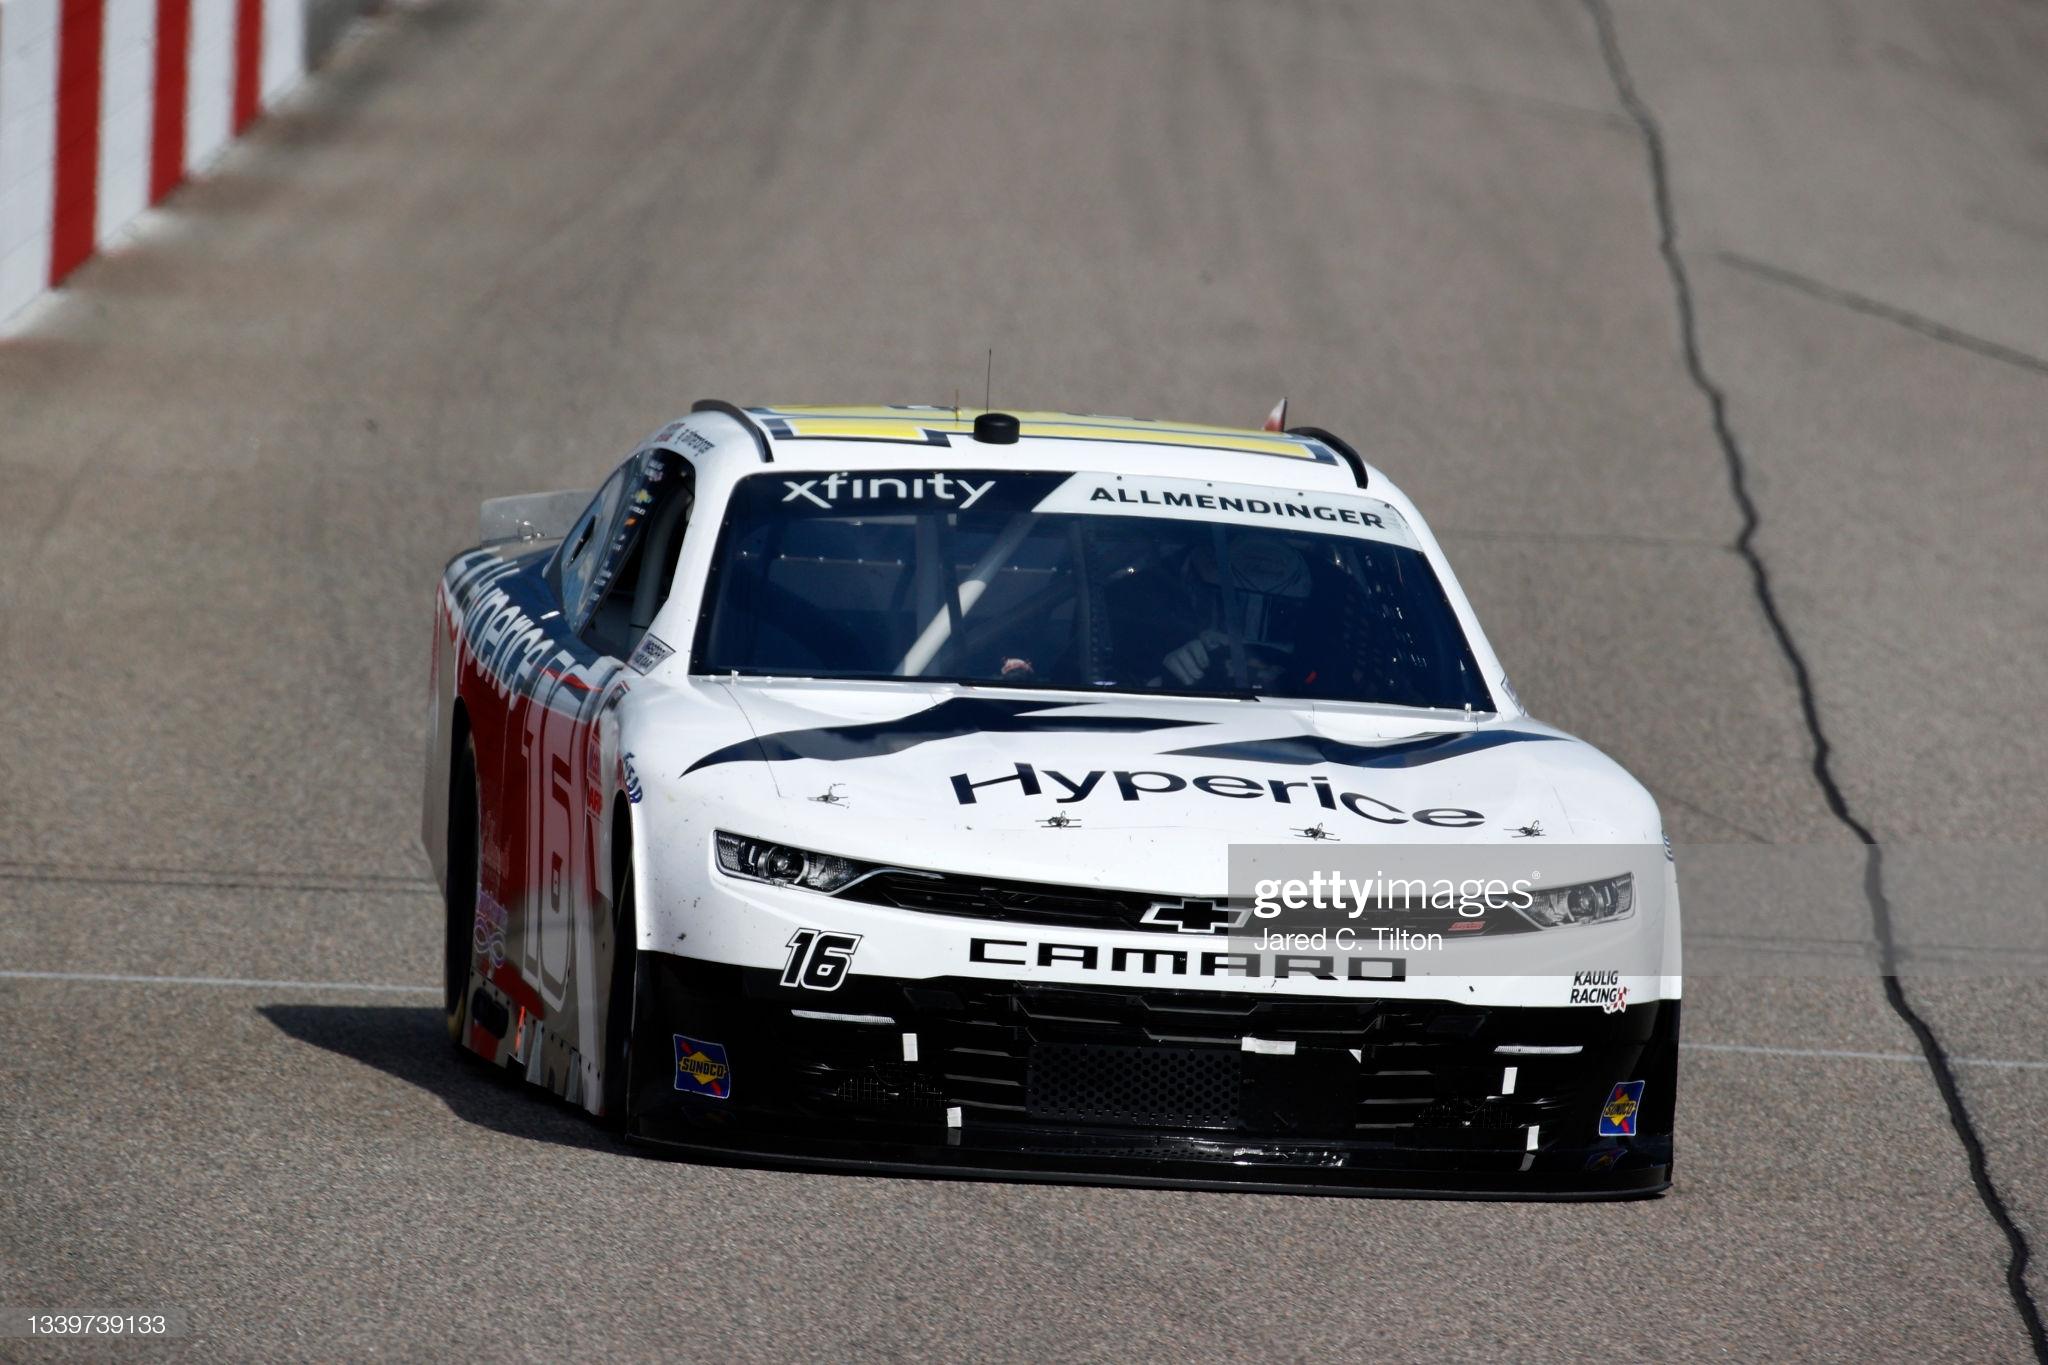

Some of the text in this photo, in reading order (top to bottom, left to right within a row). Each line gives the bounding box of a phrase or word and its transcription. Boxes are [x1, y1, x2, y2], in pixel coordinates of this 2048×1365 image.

[782, 471, 997, 510] xfinity
[1089, 486, 1386, 529] ALLMENDINGER
[949, 762, 1486, 829] Hyperice
[780, 928, 863, 992] 16
[968, 937, 1407, 983] CAMARO
[1573, 970, 1619, 986] KAULIG
[1570, 987, 1617, 1004] RACING
[682, 1057, 725, 1079] SUNOCO
[1604, 1101, 1636, 1117] SUNOCO
